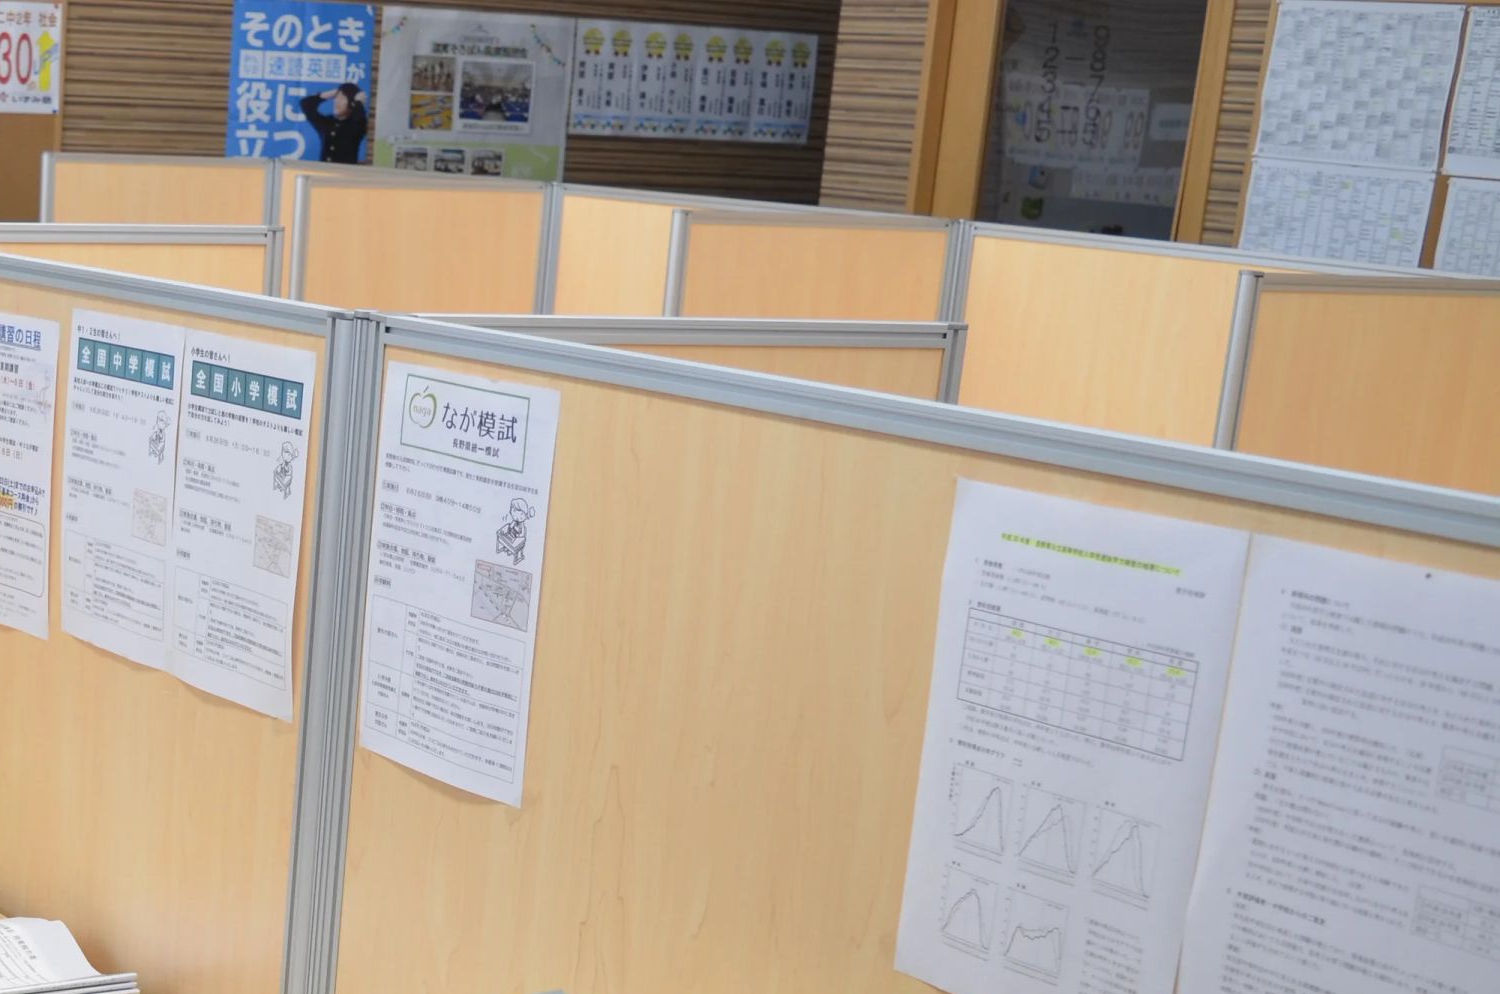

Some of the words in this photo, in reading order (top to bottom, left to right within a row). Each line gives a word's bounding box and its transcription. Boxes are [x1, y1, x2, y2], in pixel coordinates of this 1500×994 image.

[240, 11, 365, 52] そのとき
[236, 81, 307, 123] 役に
[235, 124, 306, 160] 立つ
[81, 345, 171, 382] 全国中学模試
[195, 369, 298, 411] 全国小学模試
[441, 402, 518, 443] なが模試
[452, 437, 501, 459] 長野県統一模試
